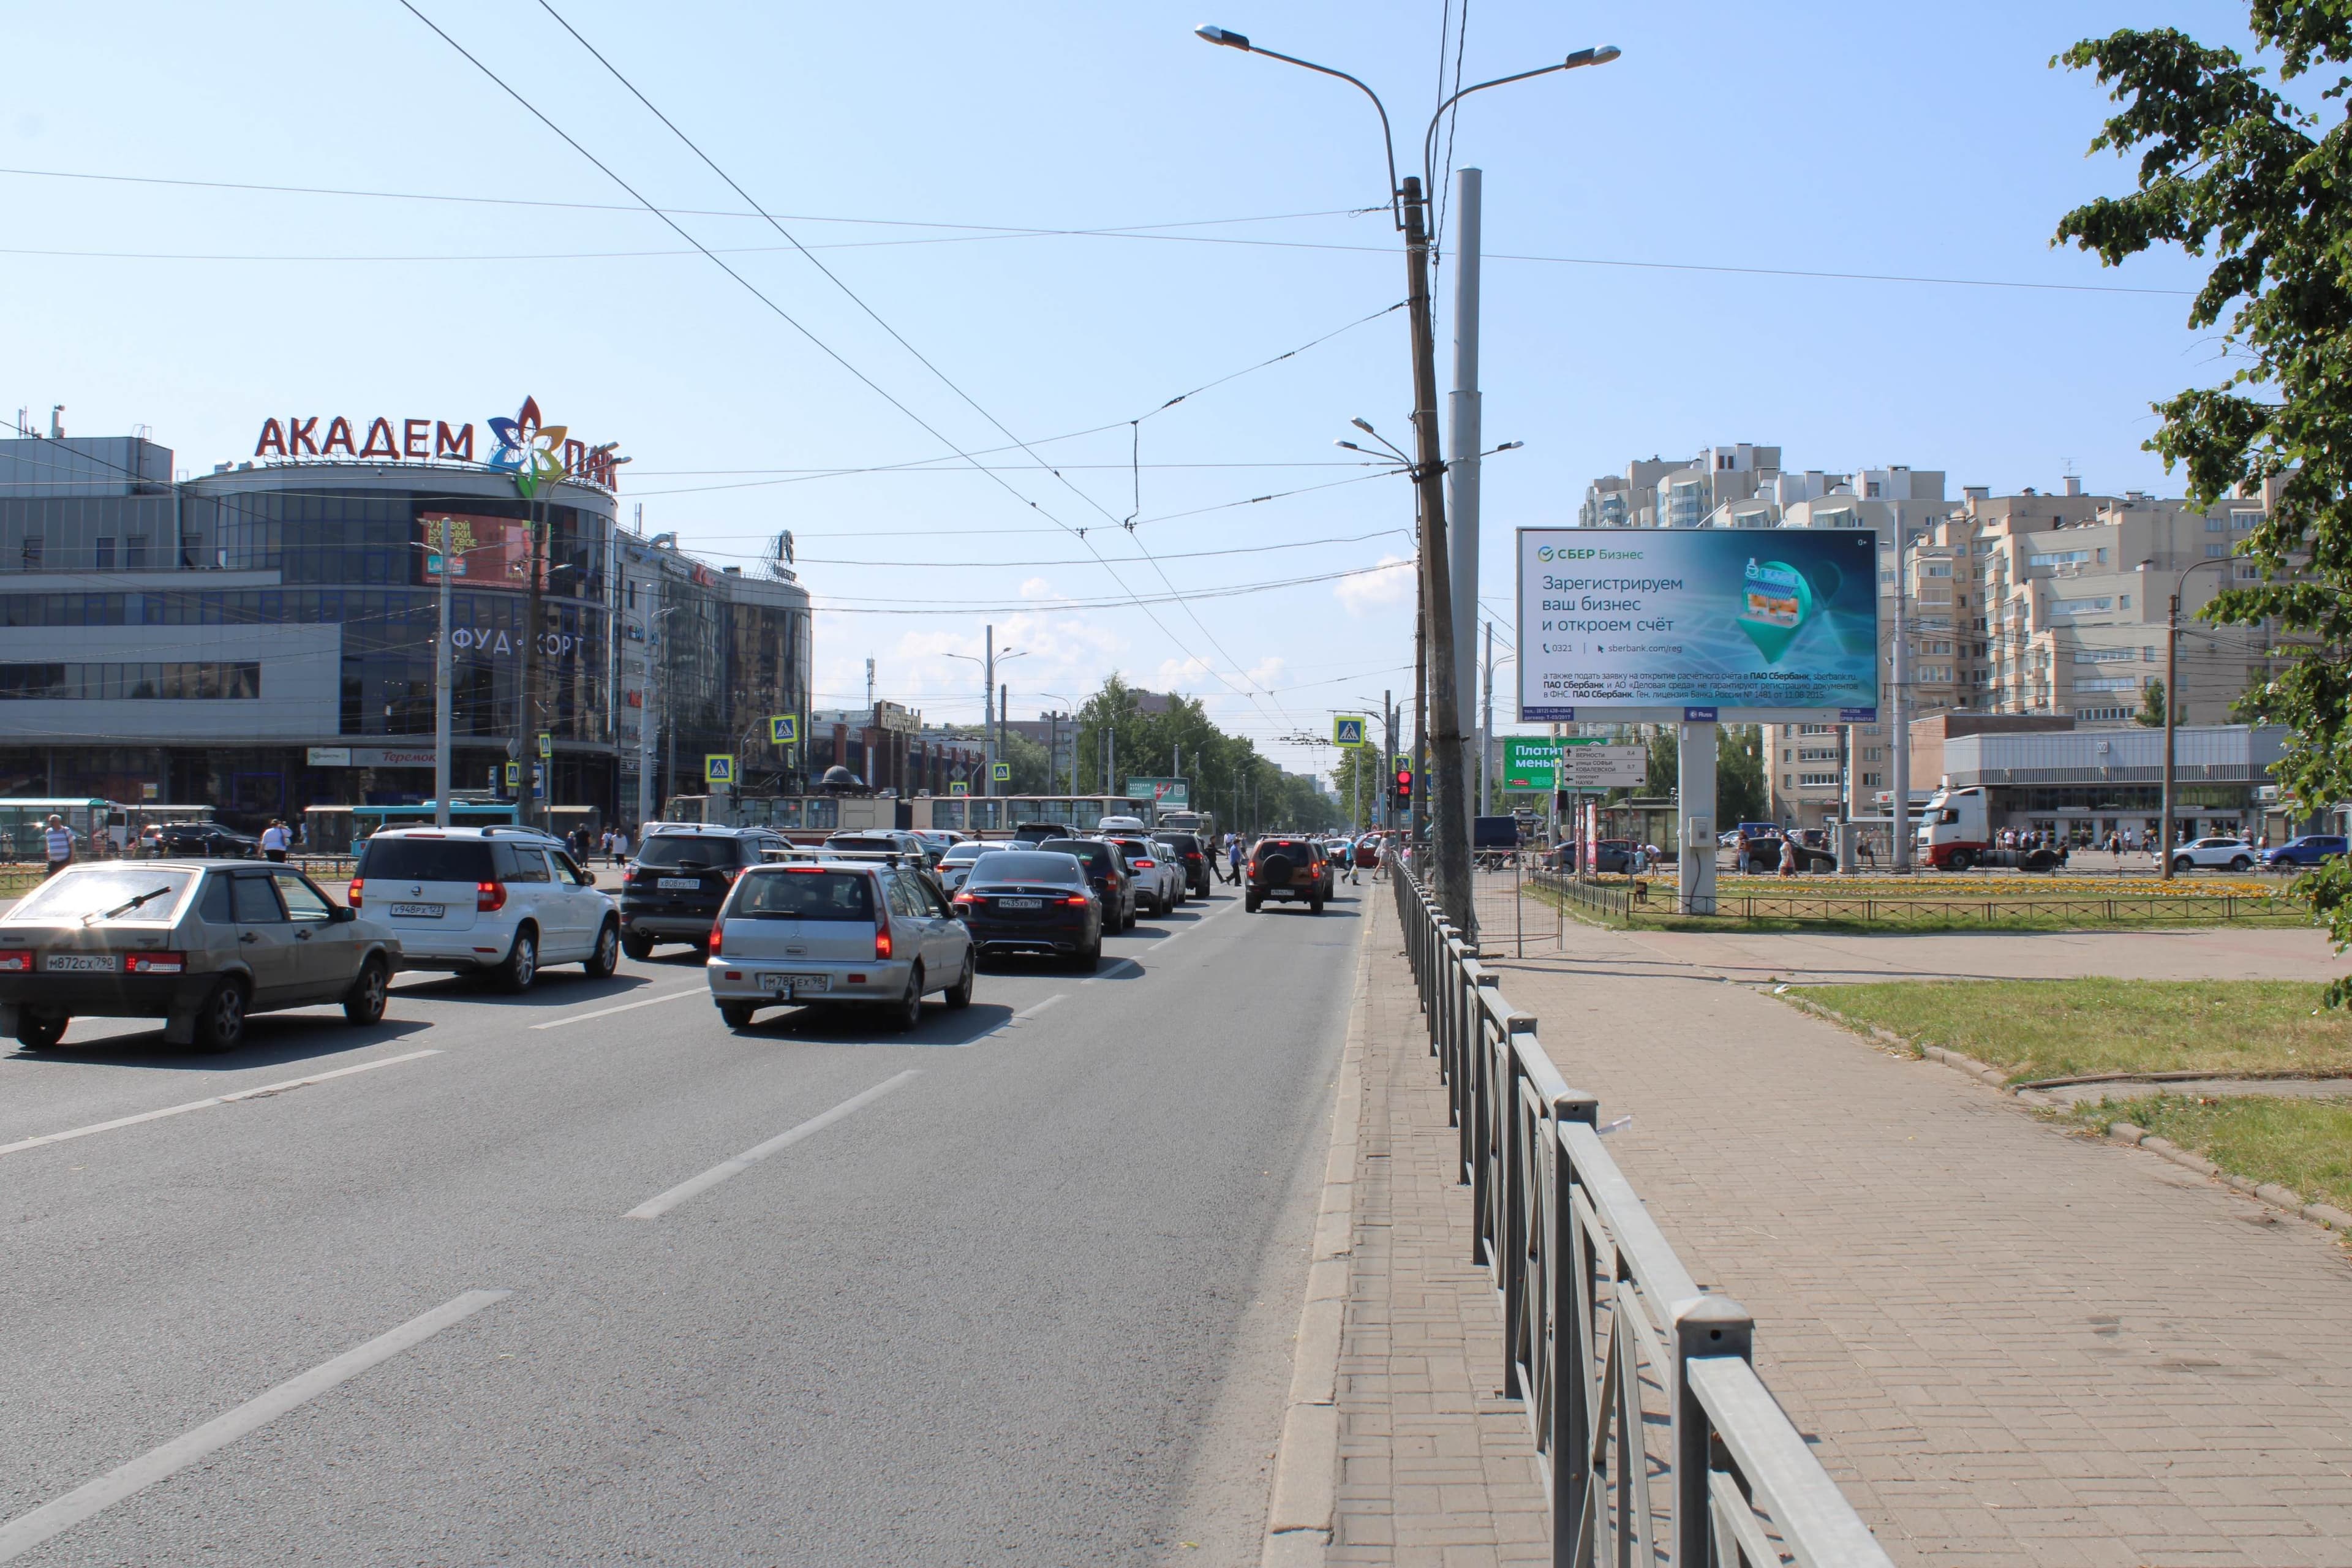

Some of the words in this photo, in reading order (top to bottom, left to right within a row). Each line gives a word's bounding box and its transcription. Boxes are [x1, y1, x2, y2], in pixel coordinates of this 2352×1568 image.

[255, 417, 473, 460] АКАДЕМ
[437, 520, 470, 530] НВОЙ
[429, 529, 471, 538] МУЫКИ
[454, 538, 477, 547] СВОЕ
[1558, 549, 1595, 560] СБЕР
[1599, 549, 1644, 560] Бизнес
[1542, 575, 1683, 593] Зарегистрируем
[1542, 600, 1575, 611] ваш
[1581, 595, 1642, 611] бизнес
[1542, 620, 1552, 631] и
[1558, 620, 1631, 634] откроем
[1637, 617, 1674, 631] счёт
[452, 628, 510, 655] ФУД
[1608, 644, 1683, 655] sberbank.com/reg
[1563, 681, 1604, 690] Сбербанк
[382, 752, 436, 763] Теремок
[96, 957, 113, 967] 790
